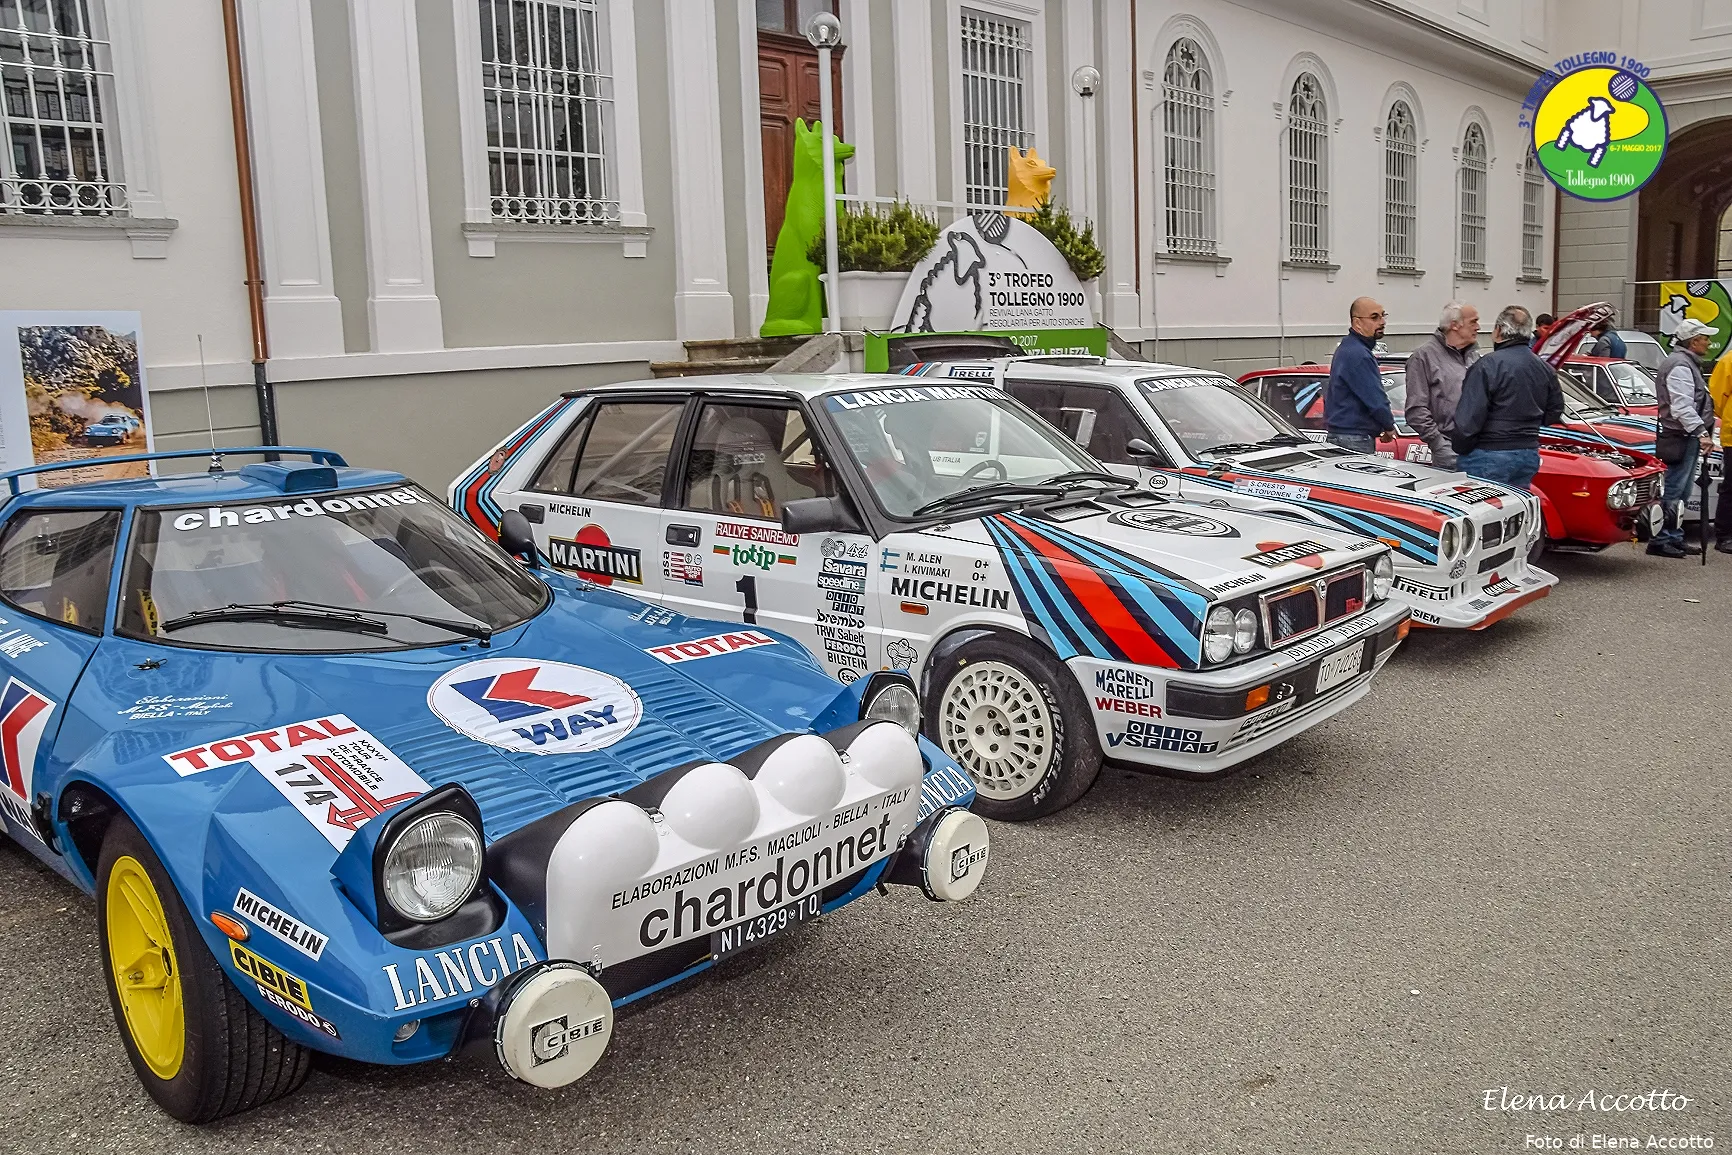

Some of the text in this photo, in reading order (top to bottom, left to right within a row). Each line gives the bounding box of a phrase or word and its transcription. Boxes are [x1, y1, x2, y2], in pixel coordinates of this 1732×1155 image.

[989, 272, 1053, 288] 3° TROFEO
[989, 292, 1085, 307] TOLLEGNO 1900
[989, 308, 1053, 318] REVIVAL LANA GATTO
[1029, 319, 1041, 327] PER
[1042, 318, 1058, 326] AUTO
[1058, 318, 1085, 326] STORICHE
[1019, 335, 1038, 347] 2017
[949, 366, 995, 378] PIRELLI
[1142, 378, 1197, 393] LANCIA
[832, 386, 1009, 410] LANCIA MARTINI
[1250, 481, 1286, 490] S.CRESTO
[173, 487, 430, 531] chardonnet
[549, 503, 591, 518] MICHELIN
[716, 523, 799, 546] RALLYE SANREMO
[550, 542, 638, 578] MARTINI
[732, 544, 776, 571] totip
[847, 543, 869, 558] 4x4
[906, 552, 916, 562] M.
[918, 553, 943, 565] ALEN
[1251, 540, 1331, 566] MARTINI
[823, 559, 866, 577] Savara
[904, 564, 910, 573] I.
[912, 566, 951, 579] KIVIMAKI
[818, 575, 860, 590] speedline
[1209, 572, 1267, 594] MICHELIN
[1392, 575, 1450, 601] PIRELLI
[736, 575, 757, 624] 1
[827, 591, 858, 604] OLIO
[891, 577, 1010, 610] MICHELIN
[832, 602, 864, 615] FIAT
[1413, 609, 1441, 624] SIEM
[816, 609, 865, 629] brembo
[815, 624, 865, 645] TRW Sabelt
[650, 632, 774, 662] TOTAL
[825, 640, 866, 657] FERODO
[828, 653, 868, 671] BILSTEIN
[1096, 669, 1154, 688] MAGNETI
[1321, 663, 1331, 682] TO
[135, 694, 229, 705] Elaborazioni
[1096, 682, 1154, 700] MARELLI
[129, 711, 175, 720] BIELLA
[1095, 697, 1162, 719] WEBER
[512, 704, 620, 745] WAY
[1129, 722, 1200, 741] OLIO
[169, 718, 359, 771] TOTAL
[349, 741, 373, 760] TOUR
[1144, 739, 1217, 753] FIAT
[327, 747, 379, 791] AUTOMOBILE
[338, 744, 385, 783] DE FRANCE
[275, 762, 339, 805] 174
[611, 859, 719, 910] ELABORAZIONI
[725, 847, 761, 875] M.F.S.
[768, 821, 822, 858] MAGLIOLI
[833, 804, 869, 831] BIELLA
[881, 788, 912, 811] ITALY
[639, 813, 891, 948] chardonnet
[797, 893, 817, 921] TO
[236, 892, 324, 955] MICHELIN
[381, 932, 539, 1012] LANCIA
[257, 983, 321, 1029] FERODO
